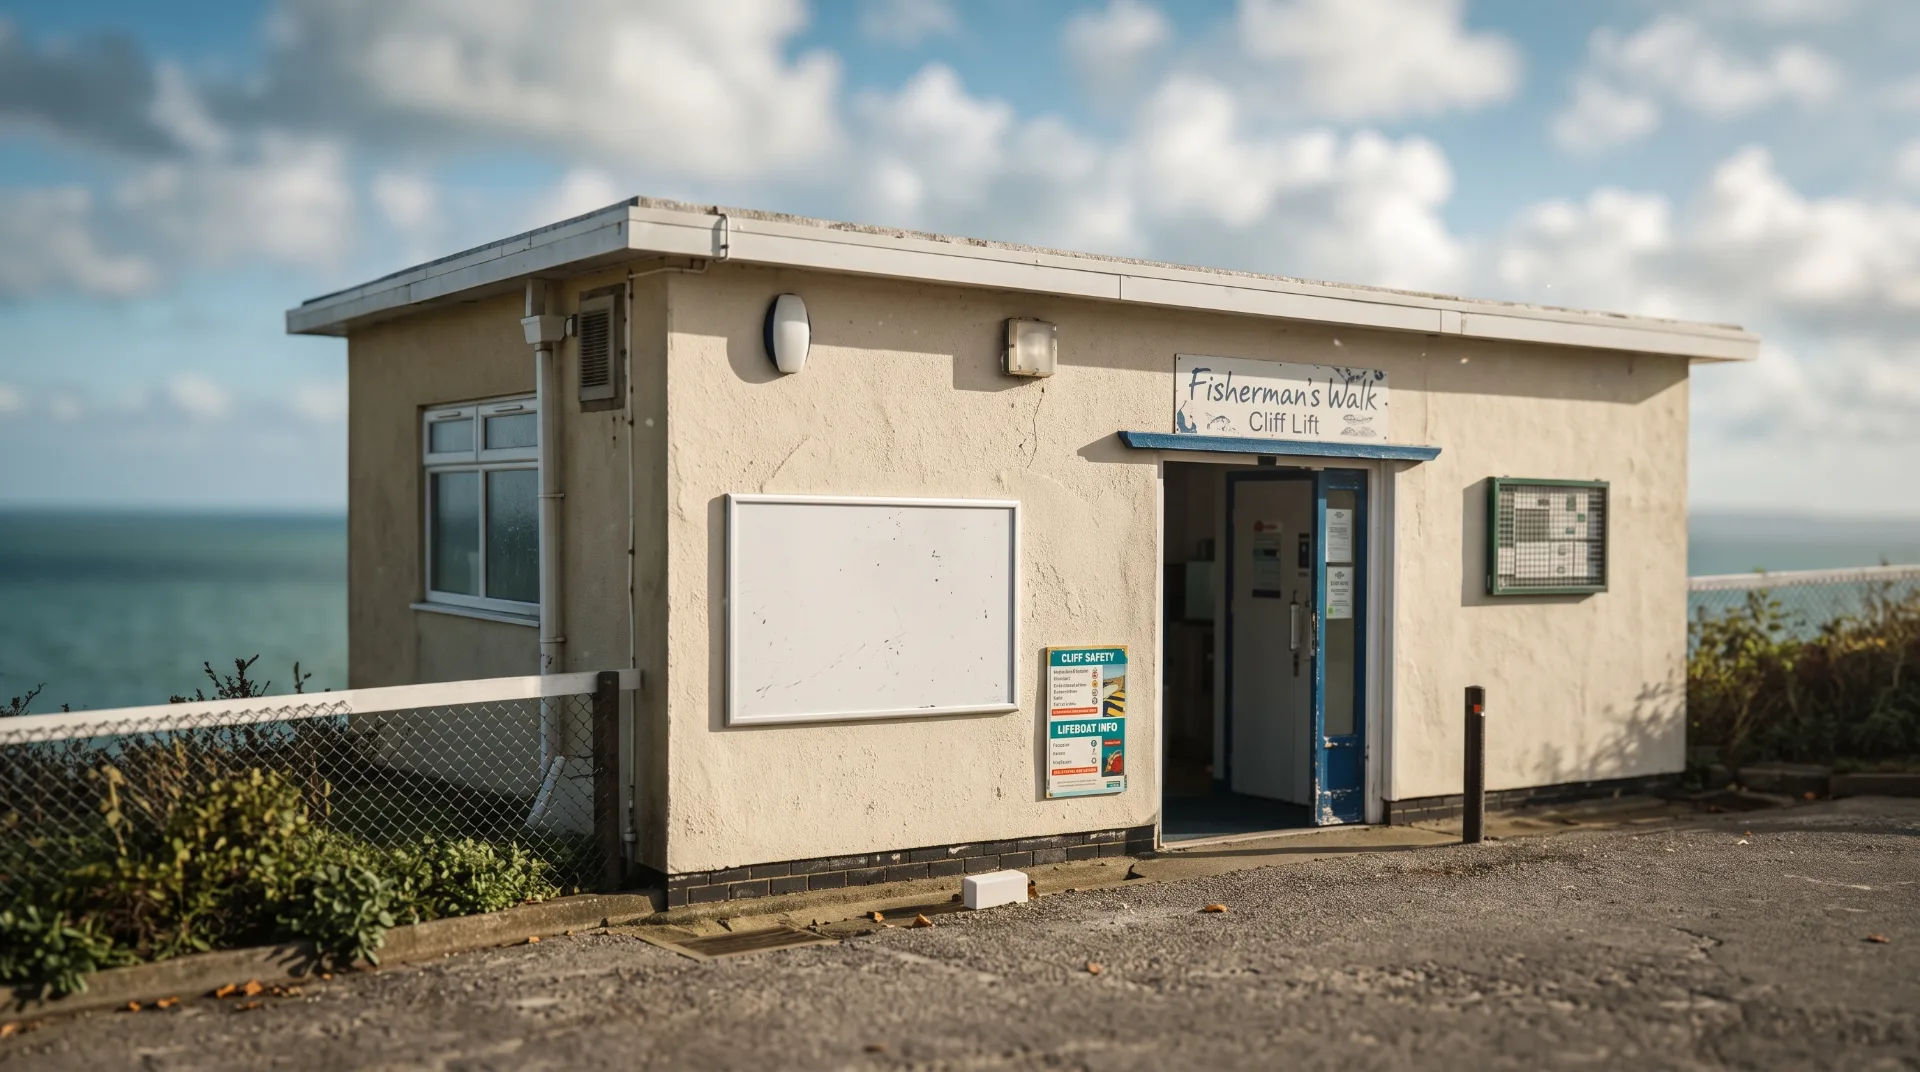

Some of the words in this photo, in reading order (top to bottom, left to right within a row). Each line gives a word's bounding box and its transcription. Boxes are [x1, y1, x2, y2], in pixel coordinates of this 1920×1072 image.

[1188, 367, 1320, 407] Fisherman's
[1328, 377, 1378, 411] Walk
[1249, 411, 1286, 434] Cliff
[1292, 413, 1320, 436] Lift
[1061, 653, 1083, 663] CLIFF
[1085, 652, 1115, 662] SAFETY
[1057, 723, 1097, 735] LIFEBOAT
[1098, 722, 1118, 733] INFO
